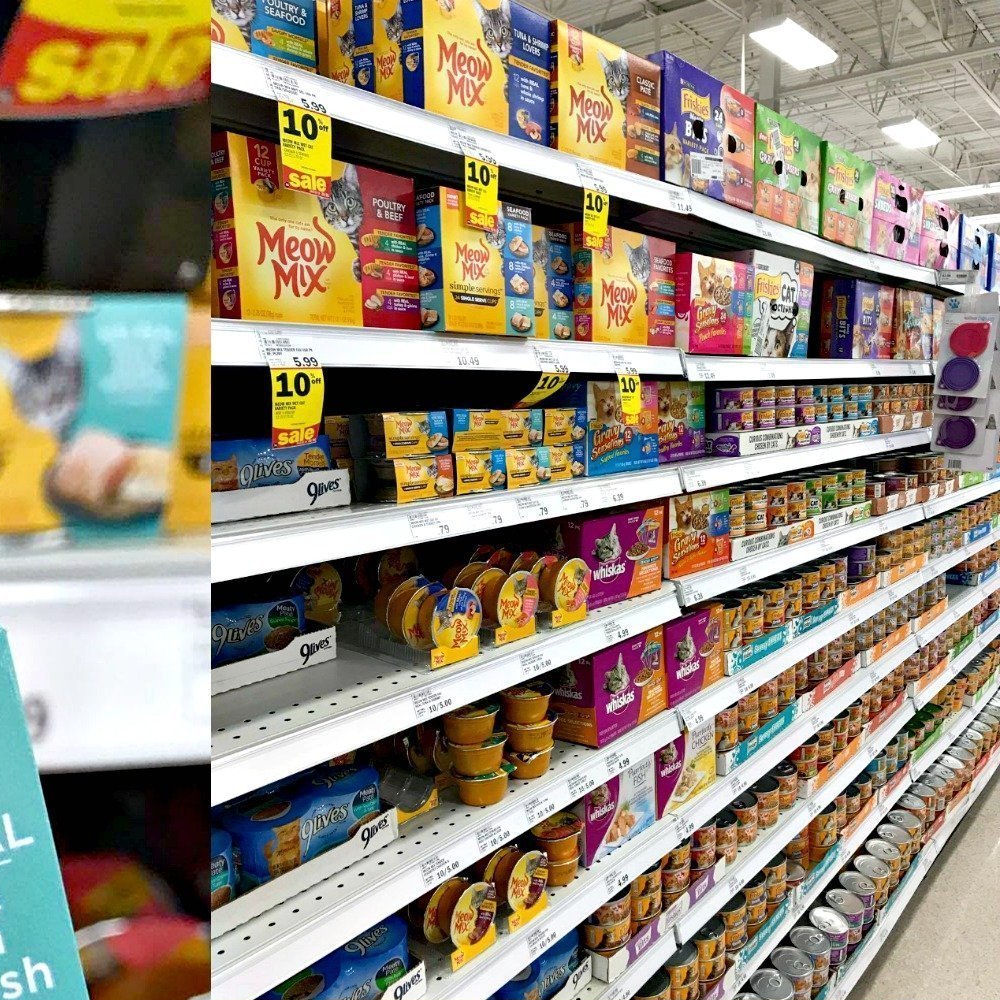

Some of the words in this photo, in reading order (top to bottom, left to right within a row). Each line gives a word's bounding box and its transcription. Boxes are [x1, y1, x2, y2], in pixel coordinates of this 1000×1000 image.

[263, 0, 299, 14] OULTRY
[301, 8, 307, 18] &
[265, 6, 306, 26] SEAFOOD
[514, 28, 527, 42] TUNA
[532, 37, 549, 50] SHRIMP
[522, 44, 541, 57] LOVERS
[636, 76, 655, 90] CLASSIC
[301, 98, 327, 114] 5.99
[683, 93, 709, 116] Friskies
[282, 108, 318, 141] 10
[714, 109, 723, 124] 24
[254, 143, 269, 160] 12
[255, 158, 272, 167] CUP
[288, 172, 327, 192] sale
[467, 162, 490, 187] 10
[372, 198, 406, 211] POULTRY
[507, 205, 530, 217] SEAFOOD
[585, 196, 603, 213] 10
[377, 210, 383, 218] &
[384, 210, 403, 221] BEEF
[469, 211, 495, 228] sale
[586, 235, 604, 249] sale
[757, 278, 780, 295] Friskies
[782, 284, 795, 303] CAT
[293, 356, 319, 367] 5.99
[457, 356, 480, 366] 10.49
[276, 372, 310, 397] 10
[537, 376, 560, 389] 10
[621, 377, 636, 393] 10
[277, 427, 315, 446] sale
[593, 562, 626, 581] whiskas
[676, 661, 700, 680] whiskas
[429, 698, 452, 714] 10/5.00
[606, 690, 635, 714] whiskas
[618, 758, 630, 769] 4.99
[660, 760, 682, 778] whiskas
[437, 861, 460, 879] 10/5.00
[617, 875, 629, 887] 4.99
